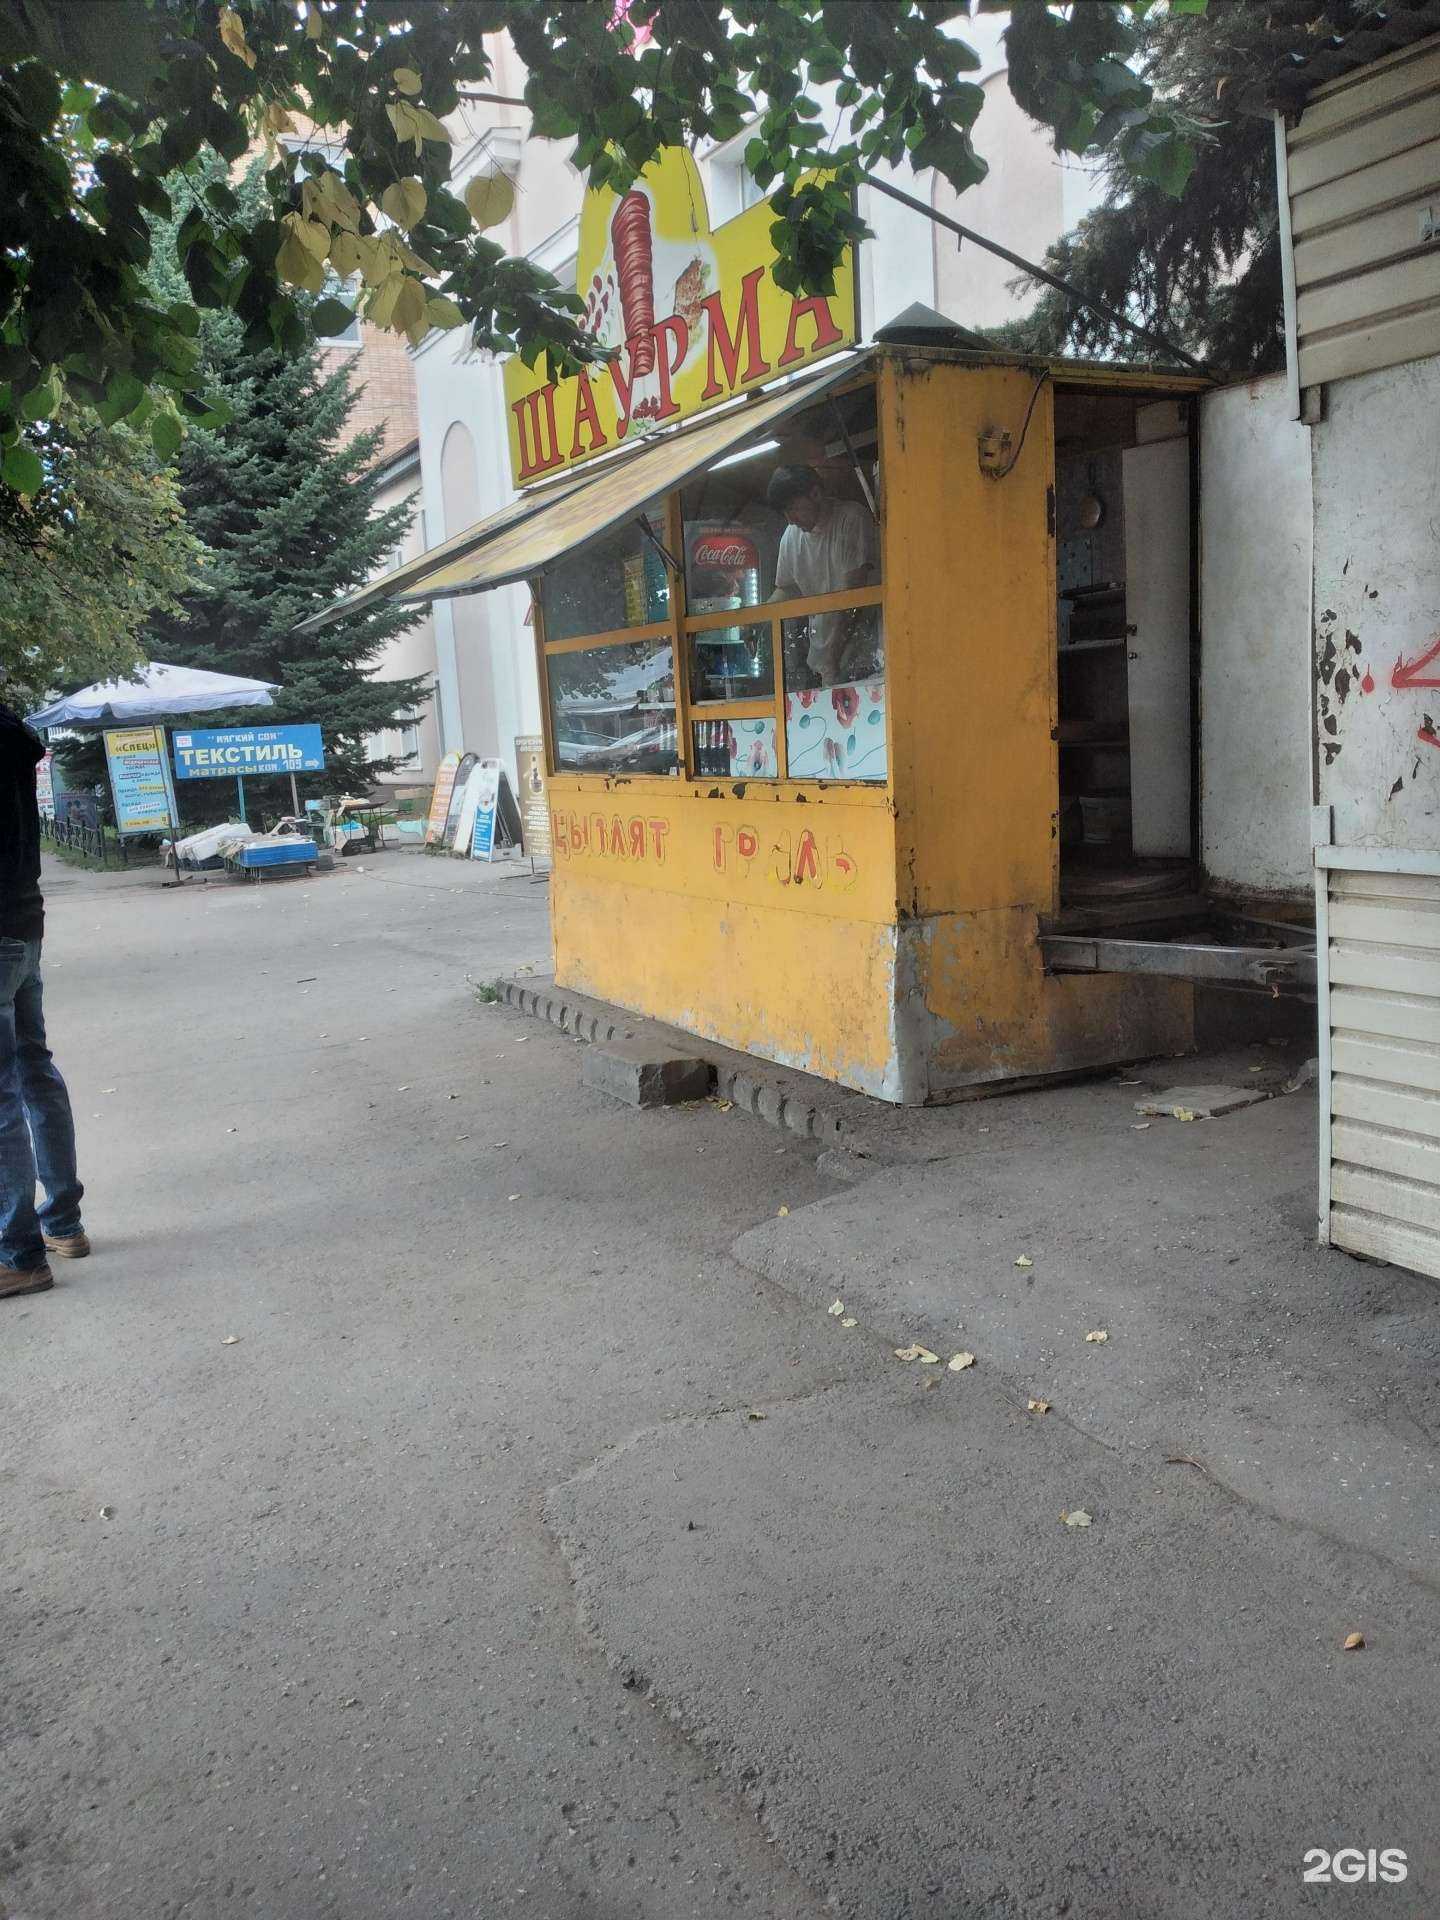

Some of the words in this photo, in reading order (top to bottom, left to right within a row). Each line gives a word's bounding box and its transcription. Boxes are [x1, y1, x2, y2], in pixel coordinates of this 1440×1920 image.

[512, 265, 843, 481] ШАУРМА
[695, 544, 746, 566] Coca-Cola
[179, 743, 303, 766] ТЕКСТИЛЬ
[282, 758, 302, 770] 109
